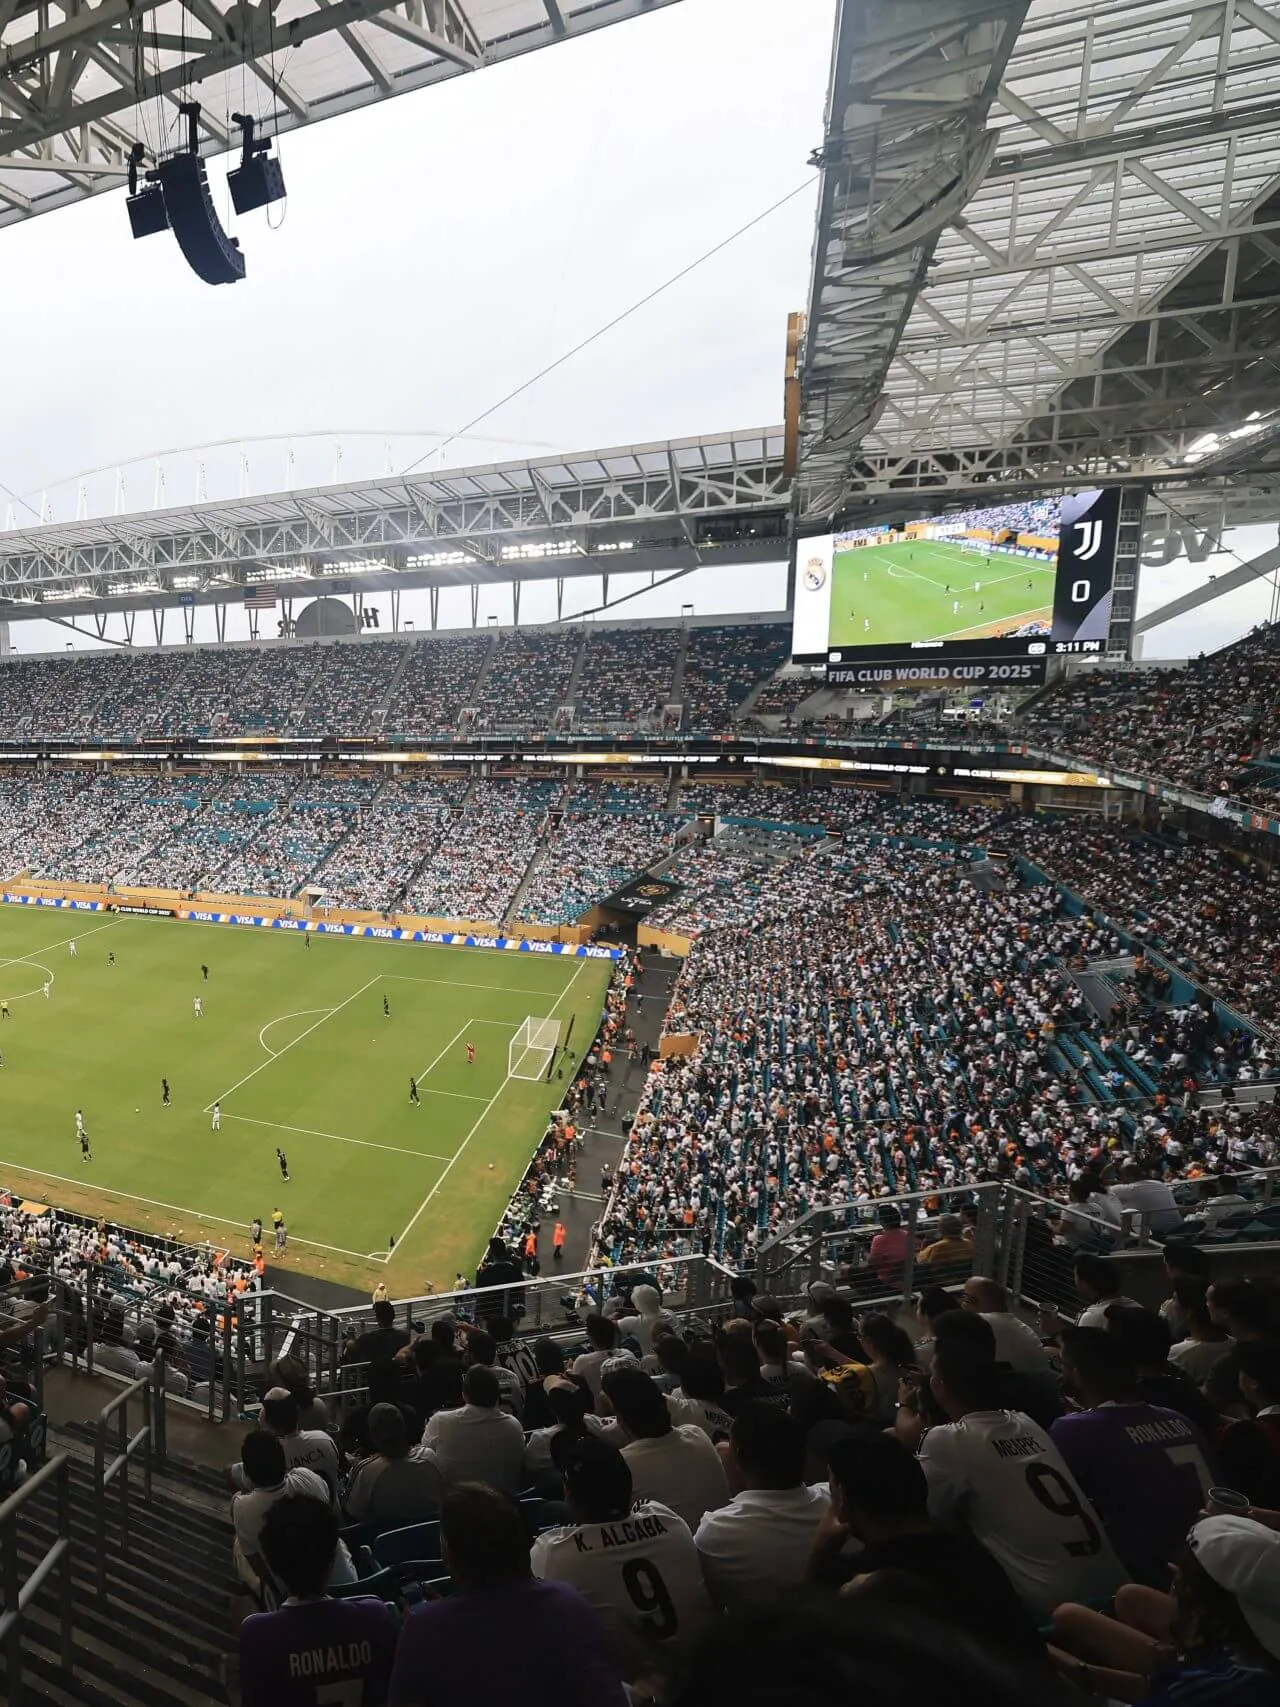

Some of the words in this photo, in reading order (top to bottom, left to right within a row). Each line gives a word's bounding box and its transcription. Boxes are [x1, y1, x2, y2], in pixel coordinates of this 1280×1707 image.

[1071, 580, 1090, 602] 0
[1055, 642, 1080, 653] 3:11
[1082, 641, 1100, 652] PM
[828, 670, 855, 682] FIFA
[857, 669, 893, 681] CLUB
[895, 667, 950, 680] WORLD
[952, 666, 985, 679] CUP
[195, 912, 213, 921] VISA
[235, 915, 255, 924] VISA
[279, 919, 299, 929] VISA
[324, 923, 345, 933] VISA
[372, 928, 393, 938] VISA
[421, 932, 444, 943] VISA
[472, 937, 497, 947] VISA
[528, 942, 553, 953] VISA
[585, 947, 611, 958] VISA
[1126, 1420, 1192, 1446] RONALDO
[1025, 1462, 1103, 1558] 9
[573, 1532, 595, 1554] K.
[600, 1514, 668, 1549] ALGABA
[621, 1557, 679, 1641] 9
[288, 1640, 372, 1678] RONALDO
